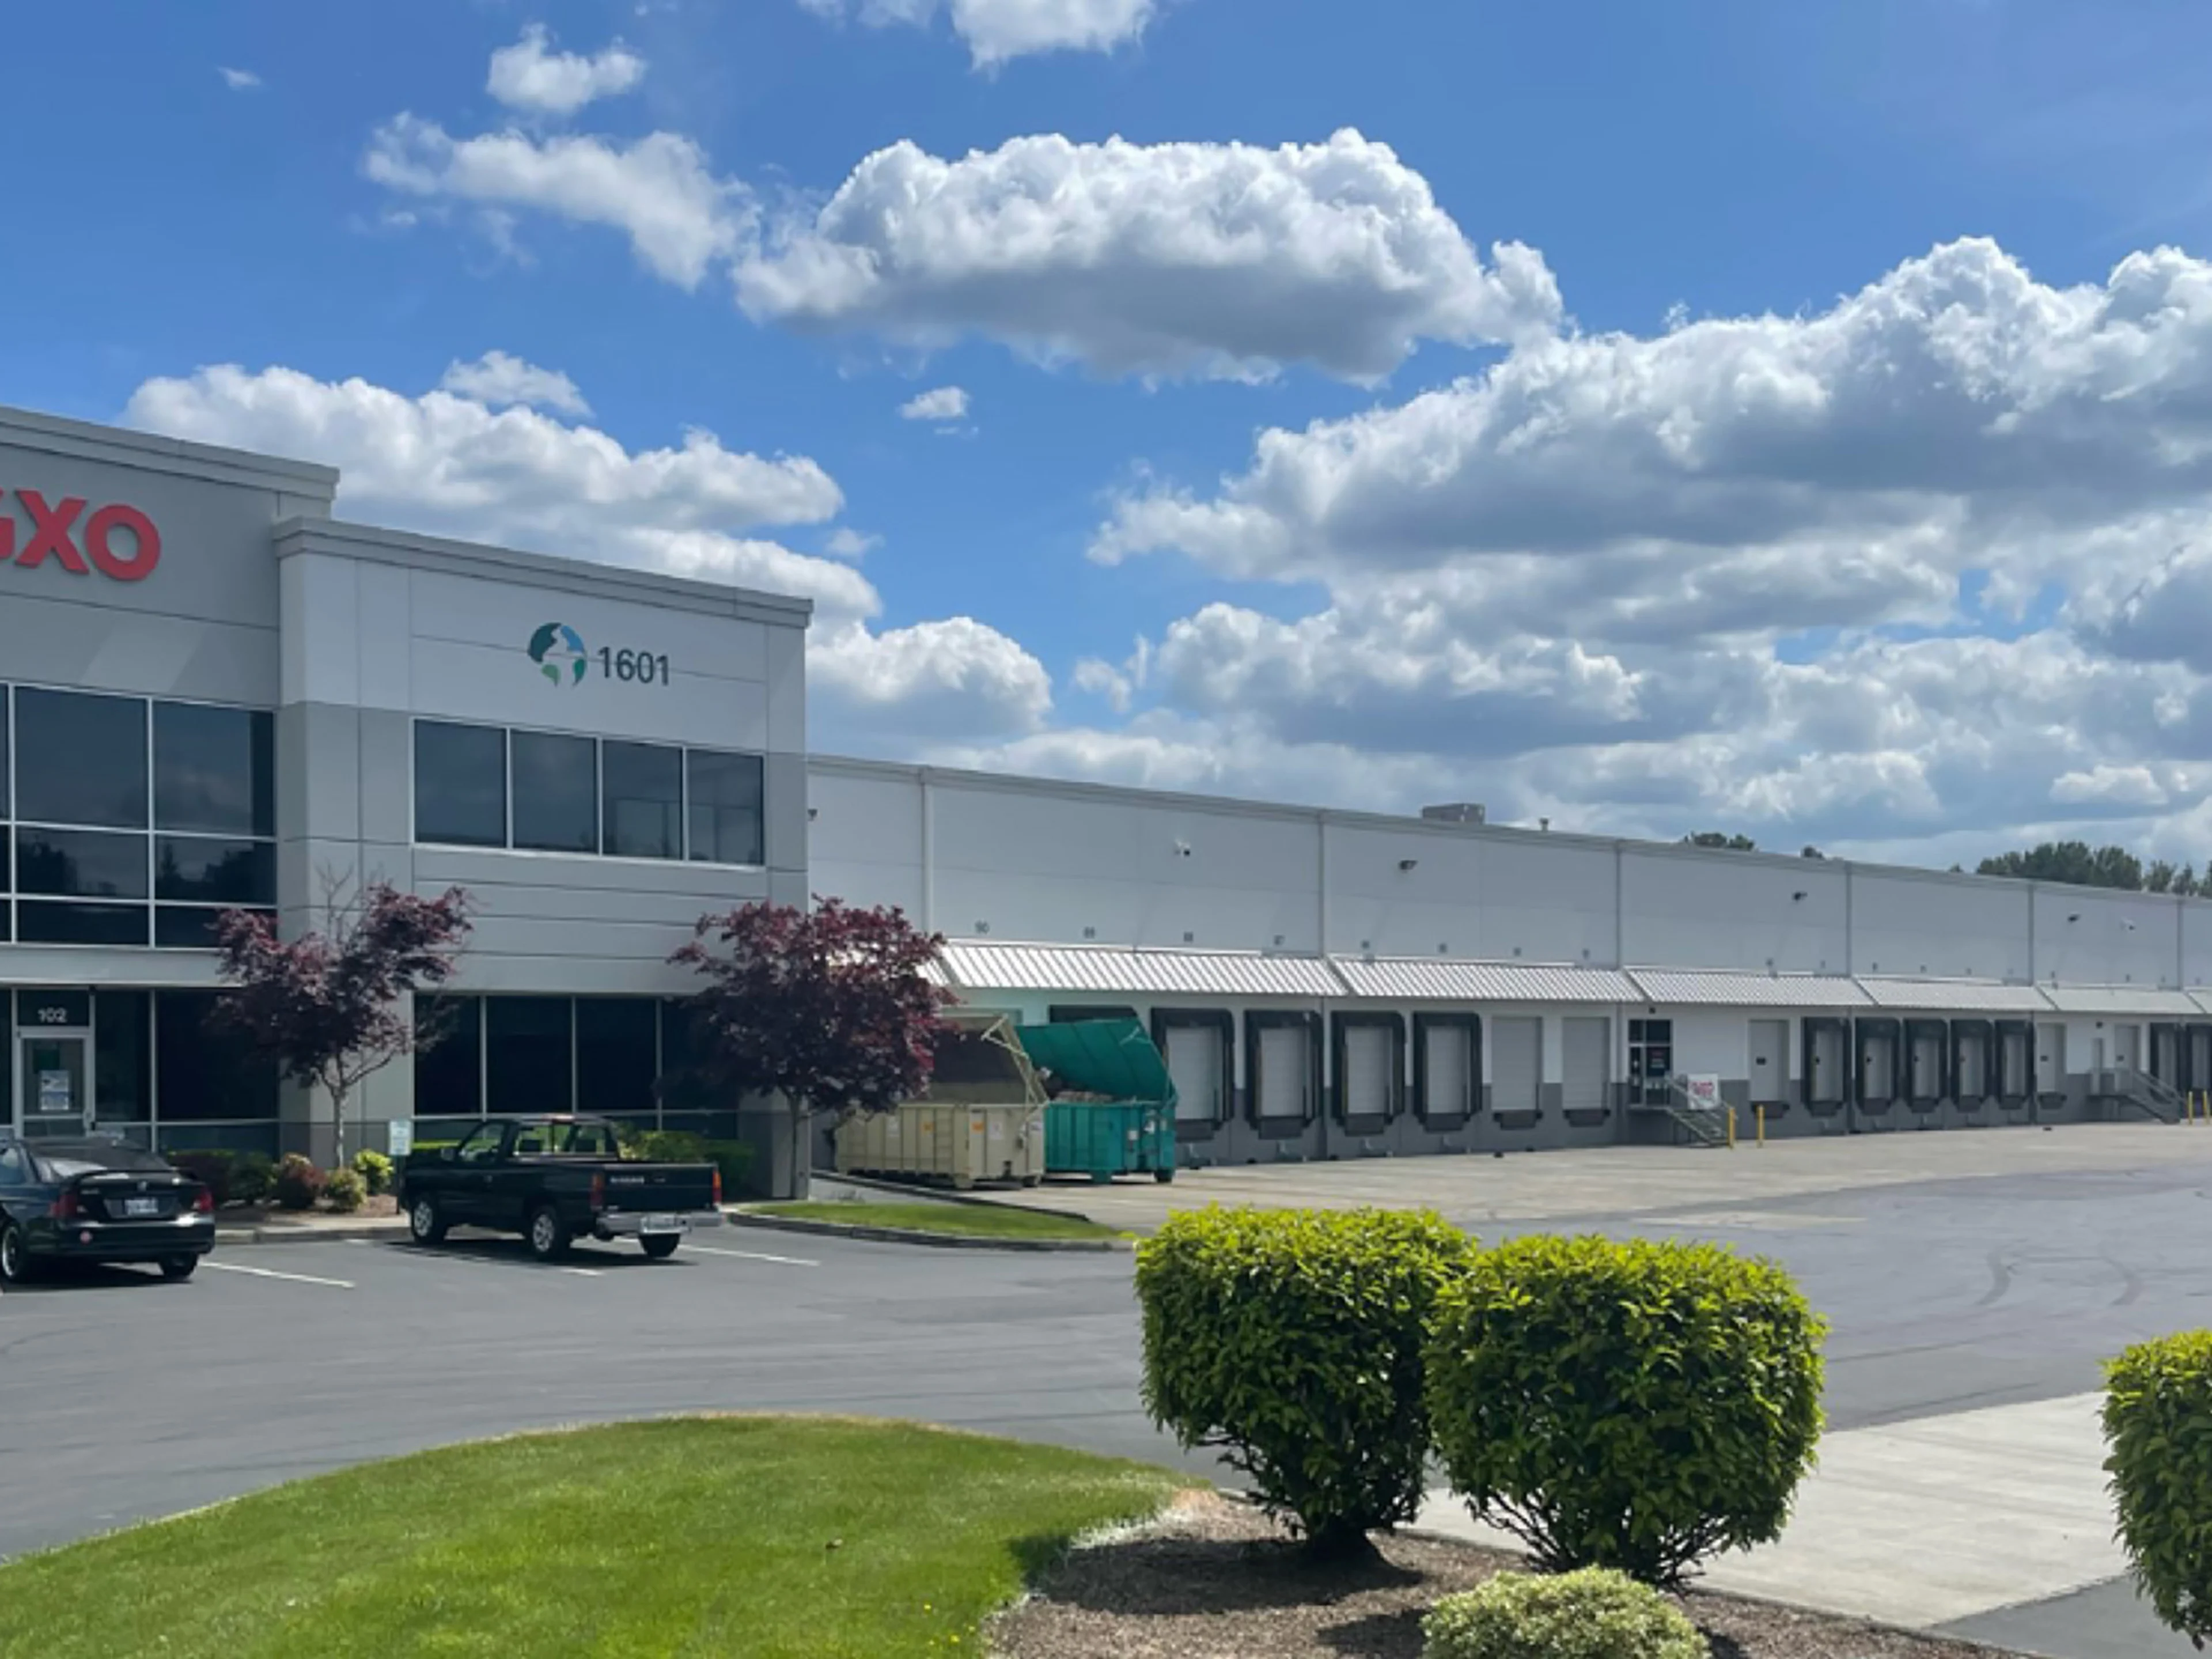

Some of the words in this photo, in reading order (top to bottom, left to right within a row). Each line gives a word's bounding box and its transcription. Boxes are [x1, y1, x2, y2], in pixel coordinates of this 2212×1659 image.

[0, 488, 161, 581] XO
[597, 646, 669, 686] 1601
[37, 1007, 67, 1023] 102
